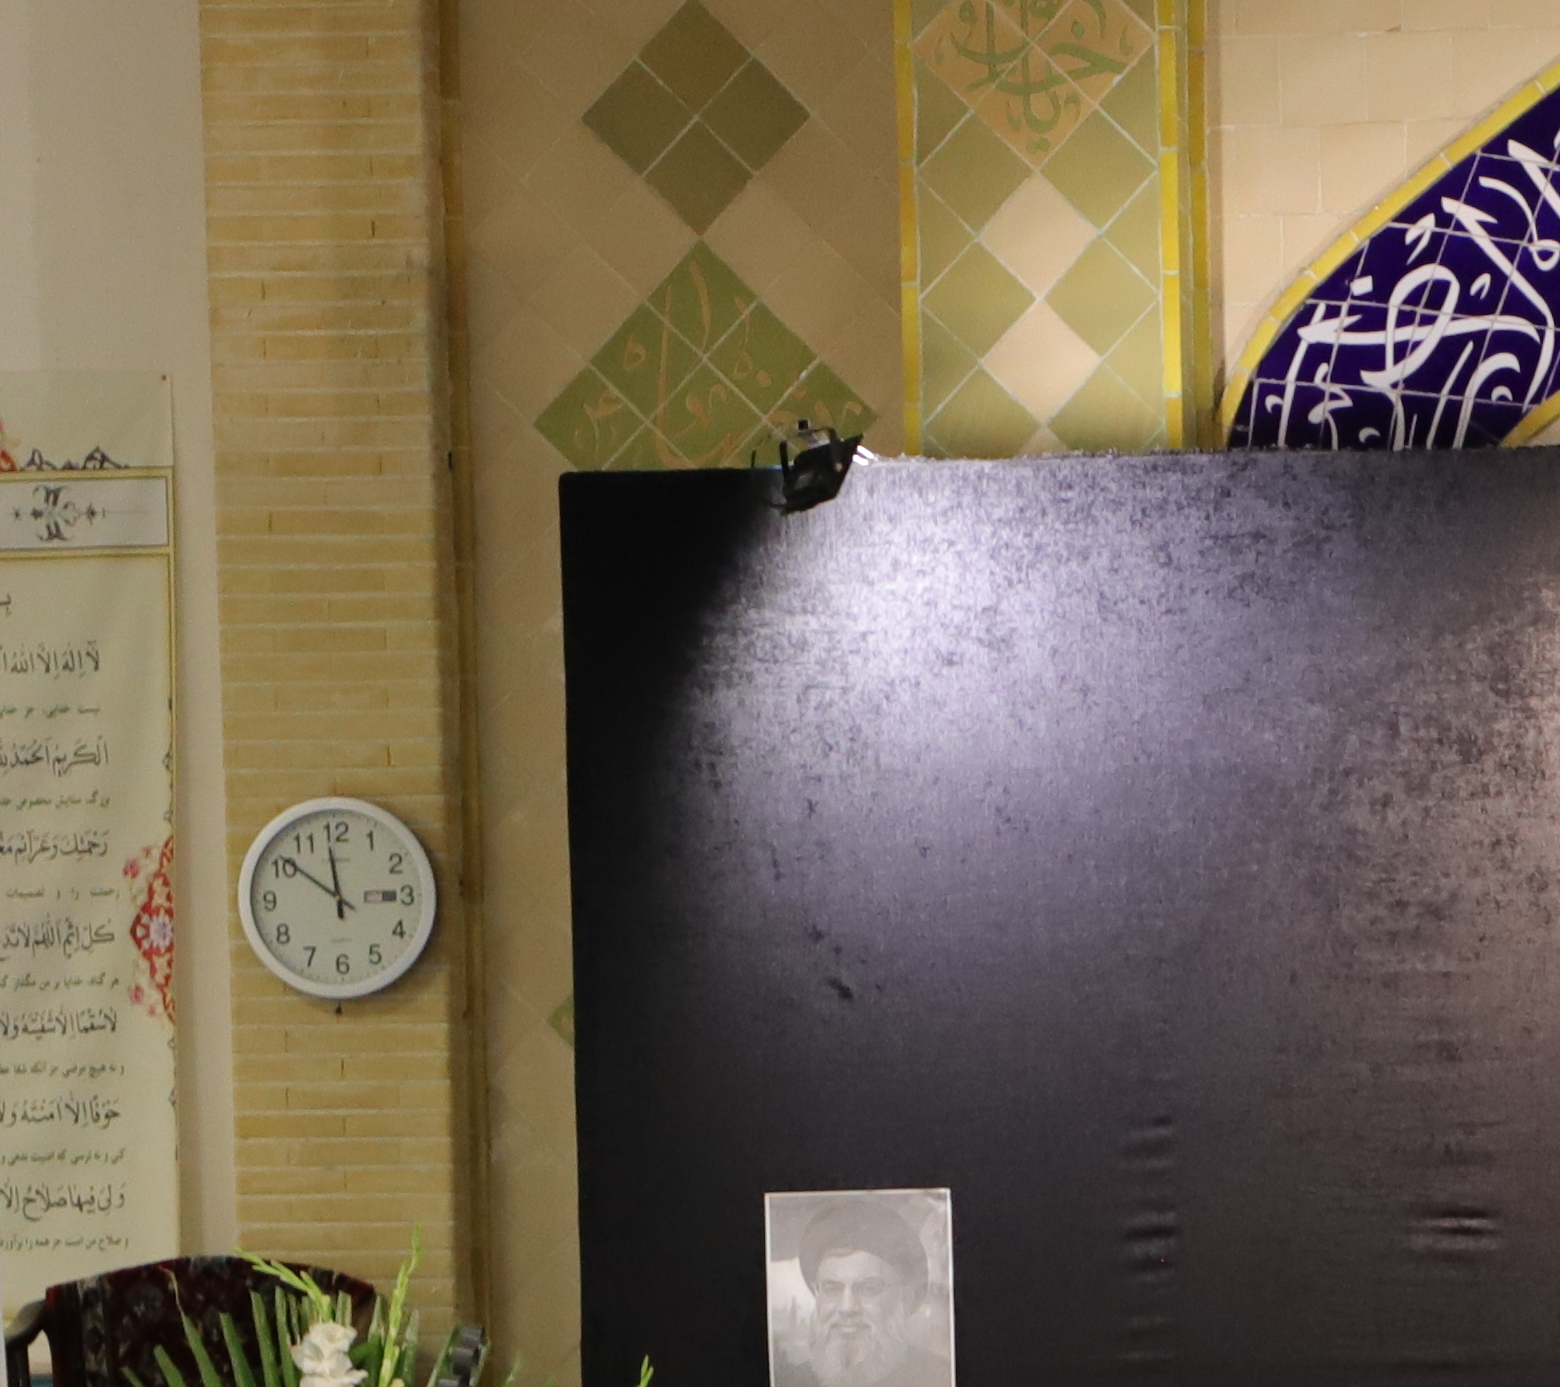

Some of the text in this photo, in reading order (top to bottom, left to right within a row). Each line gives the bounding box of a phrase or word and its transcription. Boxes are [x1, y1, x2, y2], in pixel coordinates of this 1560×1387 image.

[323, 821, 349, 842] 12
[366, 830, 374, 851] 1
[294, 833, 314, 854] 11
[389, 853, 403, 874] 2
[263, 891, 277, 912] 9
[400, 885, 415, 906] 3
[276, 924, 290, 945] 8
[392, 919, 405, 940] 4
[303, 946, 316, 967] 7
[335, 953, 350, 975] 6
[368, 943, 382, 965] 5
